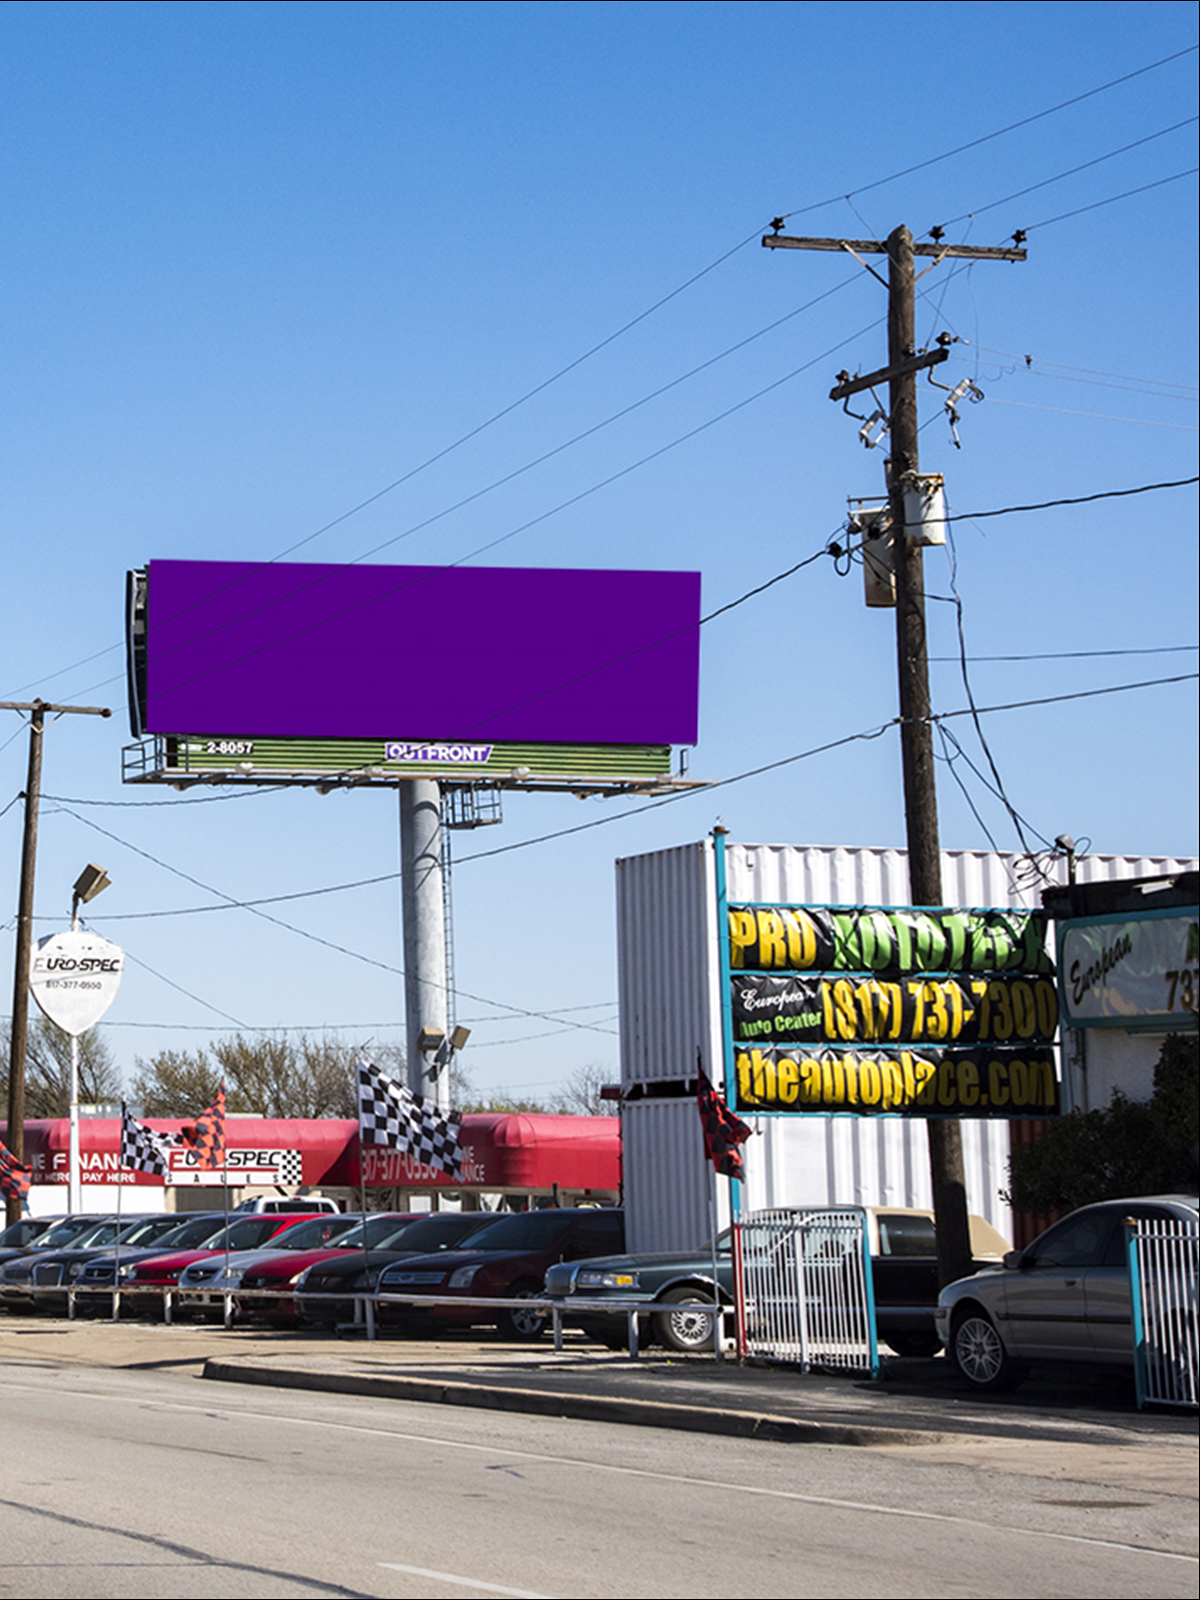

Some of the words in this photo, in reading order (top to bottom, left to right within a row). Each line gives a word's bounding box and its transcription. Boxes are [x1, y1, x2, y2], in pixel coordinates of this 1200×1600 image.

[207, 741, 253, 754] 2-8057
[729, 909, 817, 969] PRO
[1070, 933, 1132, 1006] European
[45, 980, 102, 990] 817-377-0550
[740, 988, 816, 1012] European
[908, 980, 1058, 1040] 731-7300
[739, 1020, 773, 1038] Auto
[773, 1011, 823, 1032] Center
[736, 1049, 1056, 1110] theautoplace.com
[83, 1173, 102, 1183] PAY
[106, 1173, 135, 1182] HERE
